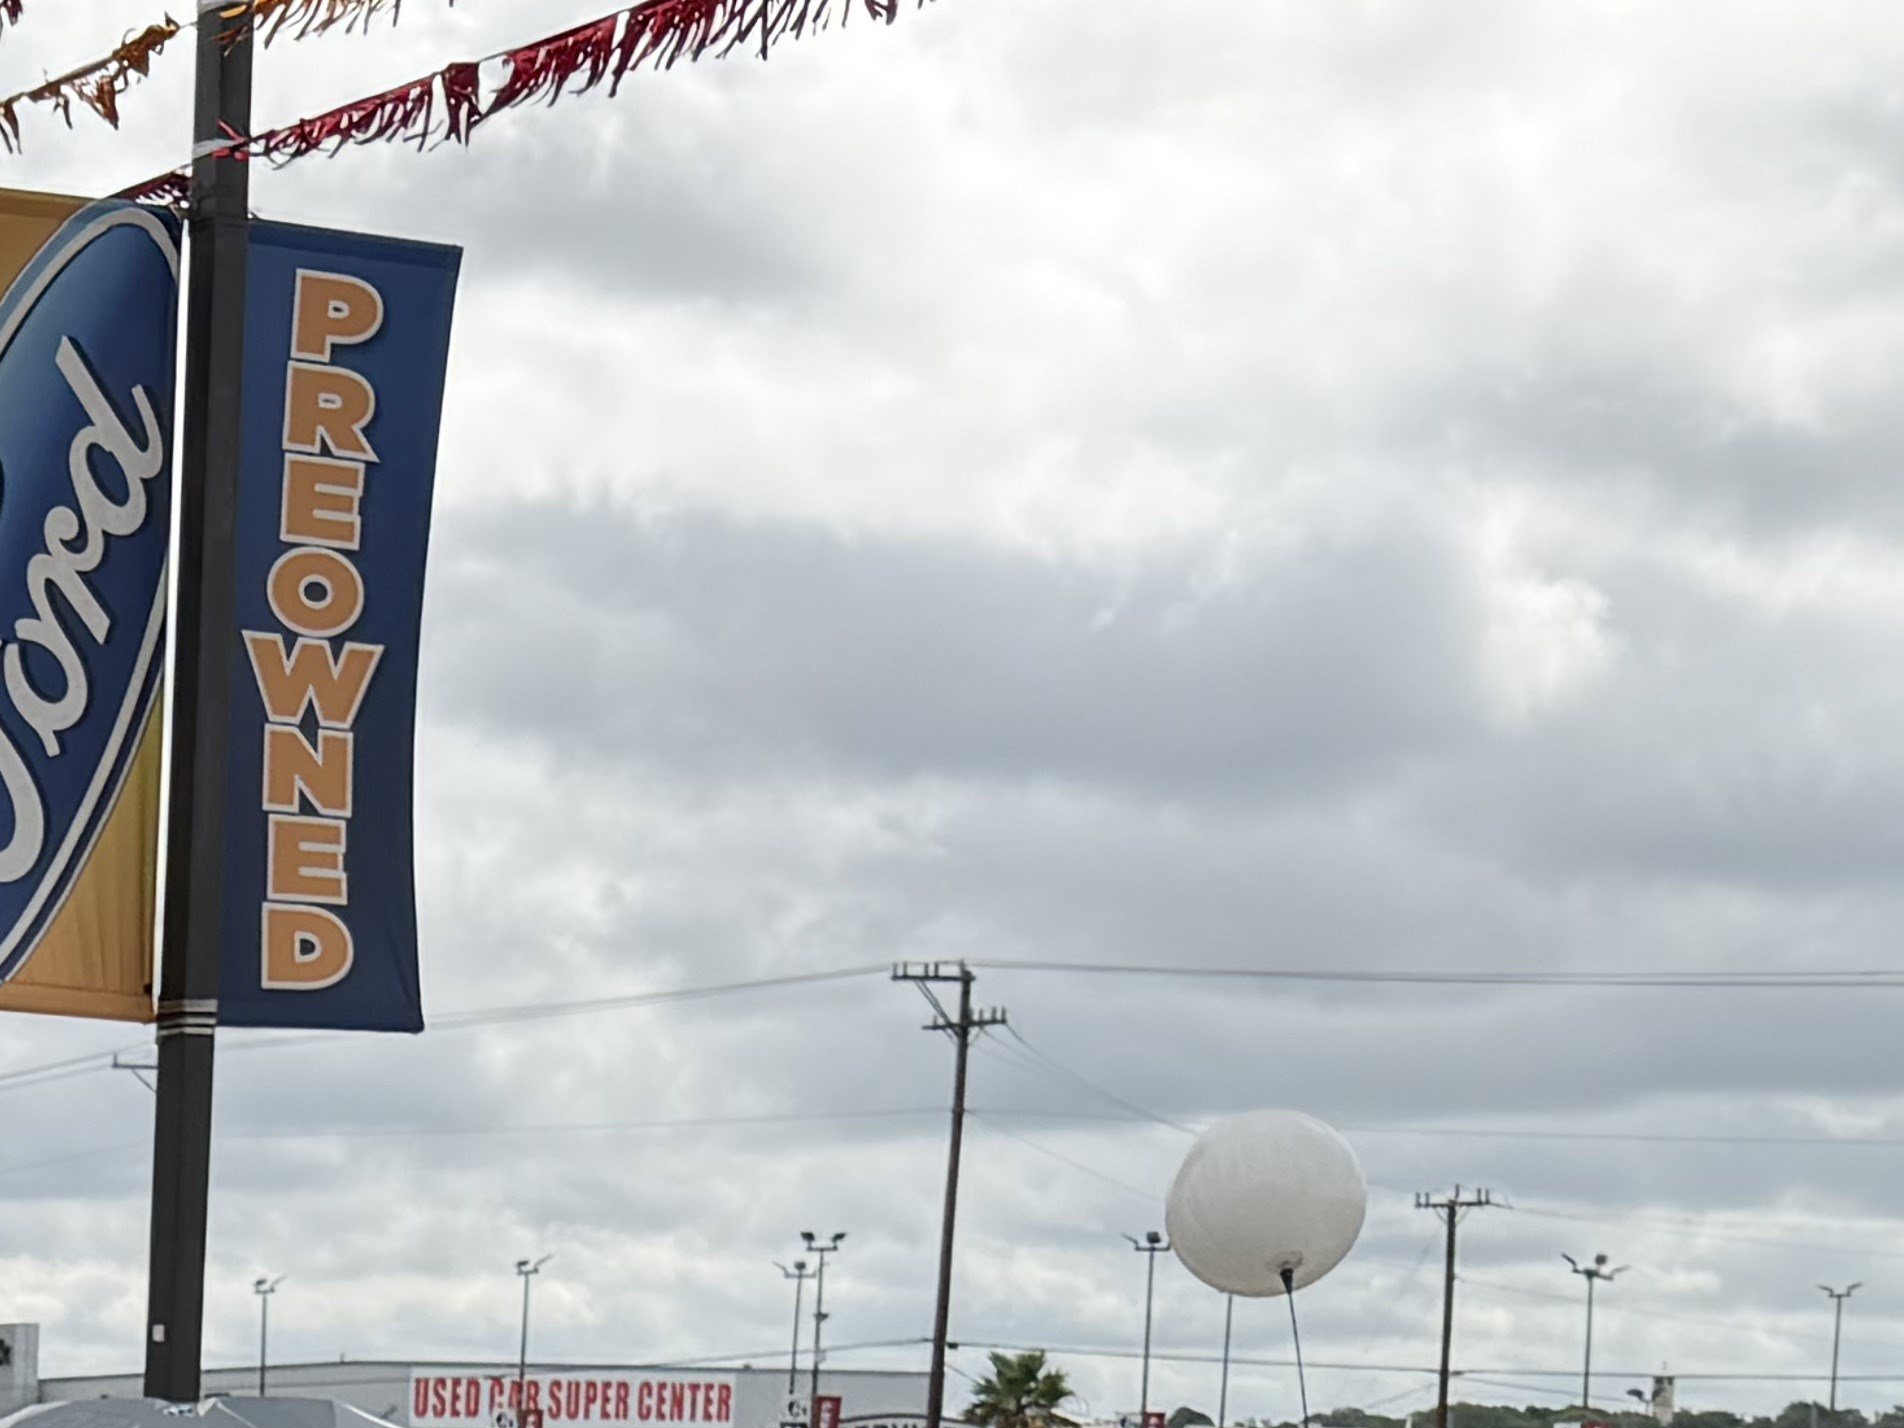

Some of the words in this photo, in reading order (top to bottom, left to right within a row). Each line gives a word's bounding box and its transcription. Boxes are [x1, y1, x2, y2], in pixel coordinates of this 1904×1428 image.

[242, 267, 385, 991] PREOWNED
[414, 1377, 481, 1419] USED
[548, 1379, 630, 1421] SUPER
[637, 1381, 732, 1423] CENTER
